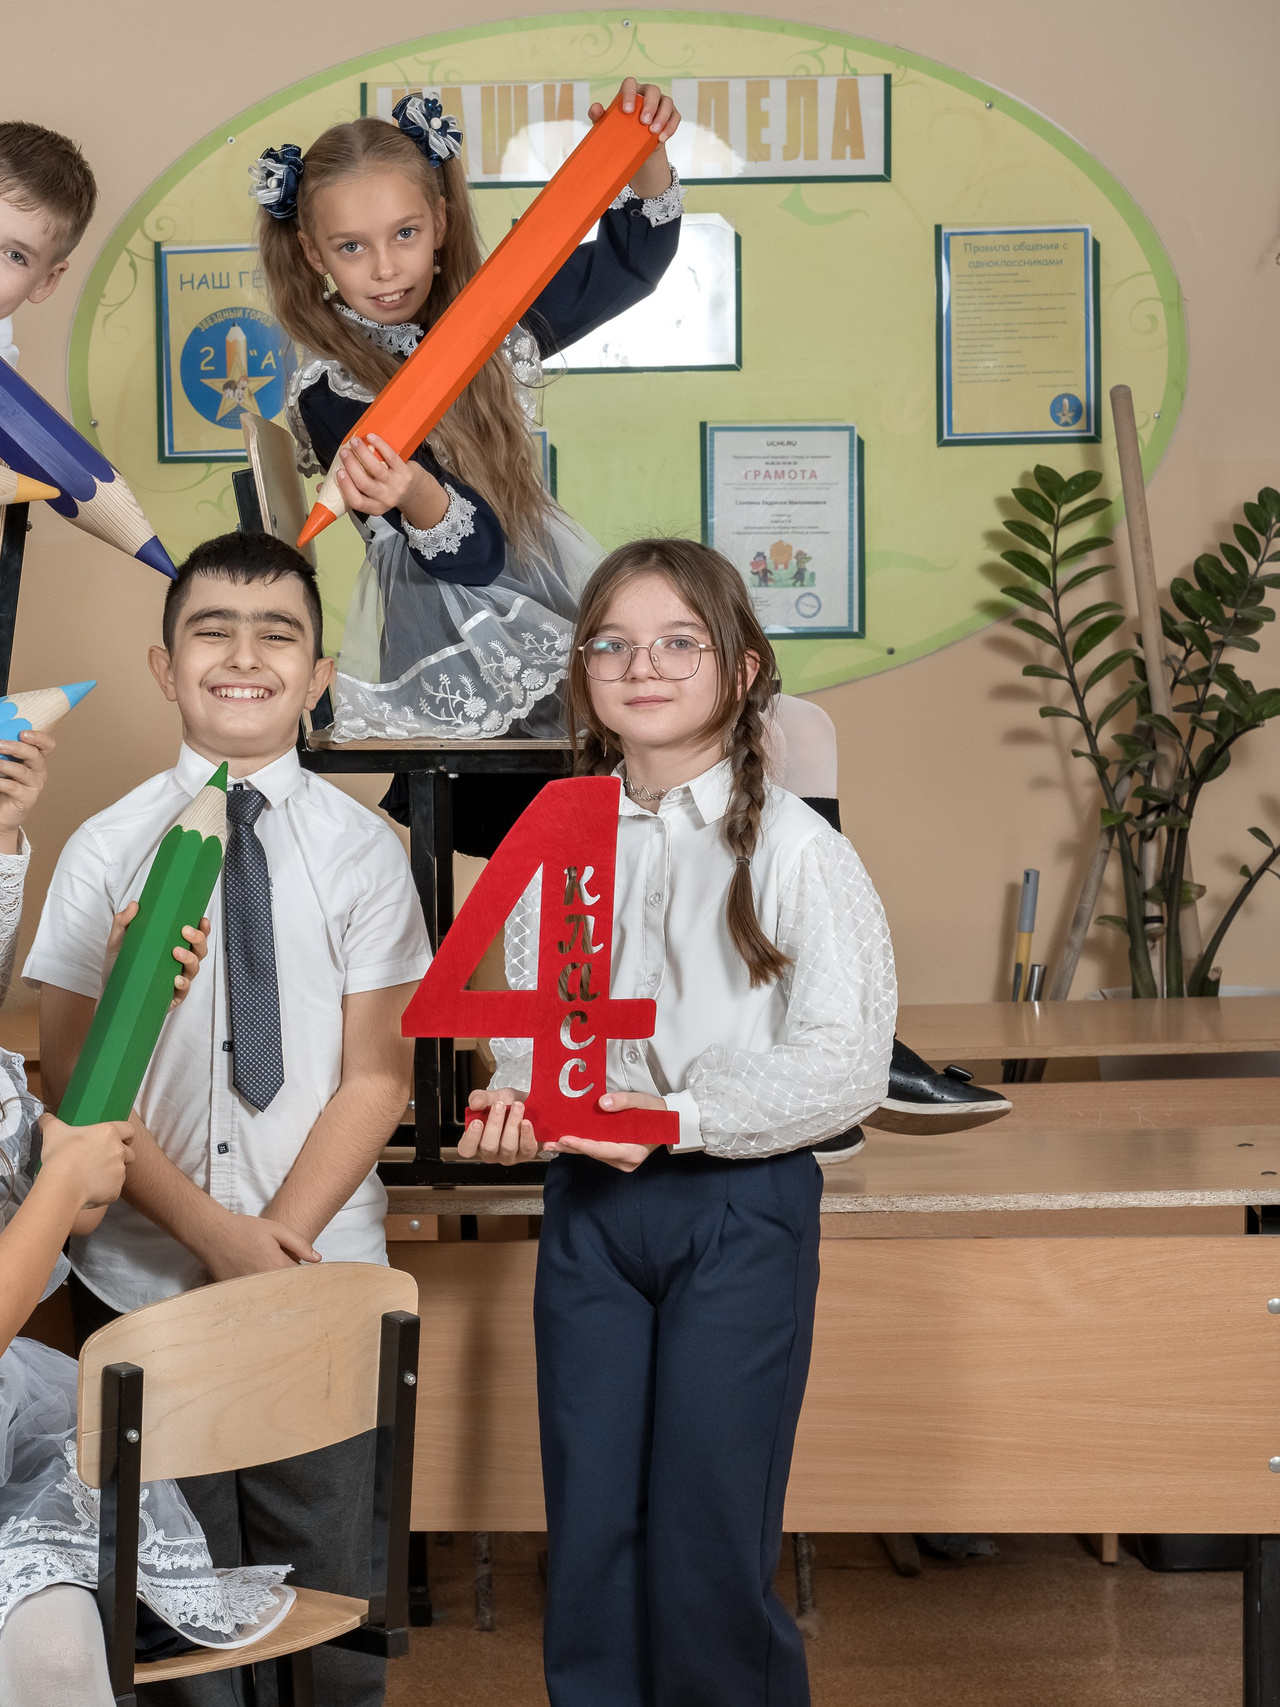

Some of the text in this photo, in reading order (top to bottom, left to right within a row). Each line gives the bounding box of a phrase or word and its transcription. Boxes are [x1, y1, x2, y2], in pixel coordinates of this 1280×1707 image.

[692, 79, 866, 176] ДЕЛА
[963, 242, 1010, 255] Правила
[1013, 241, 1059, 252] общения
[967, 258, 1063, 269] одноклассниками
[180, 271, 230, 291] НАШ
[196, 308, 243, 334] ЗВЕЗДНЫЙ
[200, 346, 216, 371] 2
[744, 469, 818, 480] ГРАМОТА
[401, 775, 680, 1145] 4
